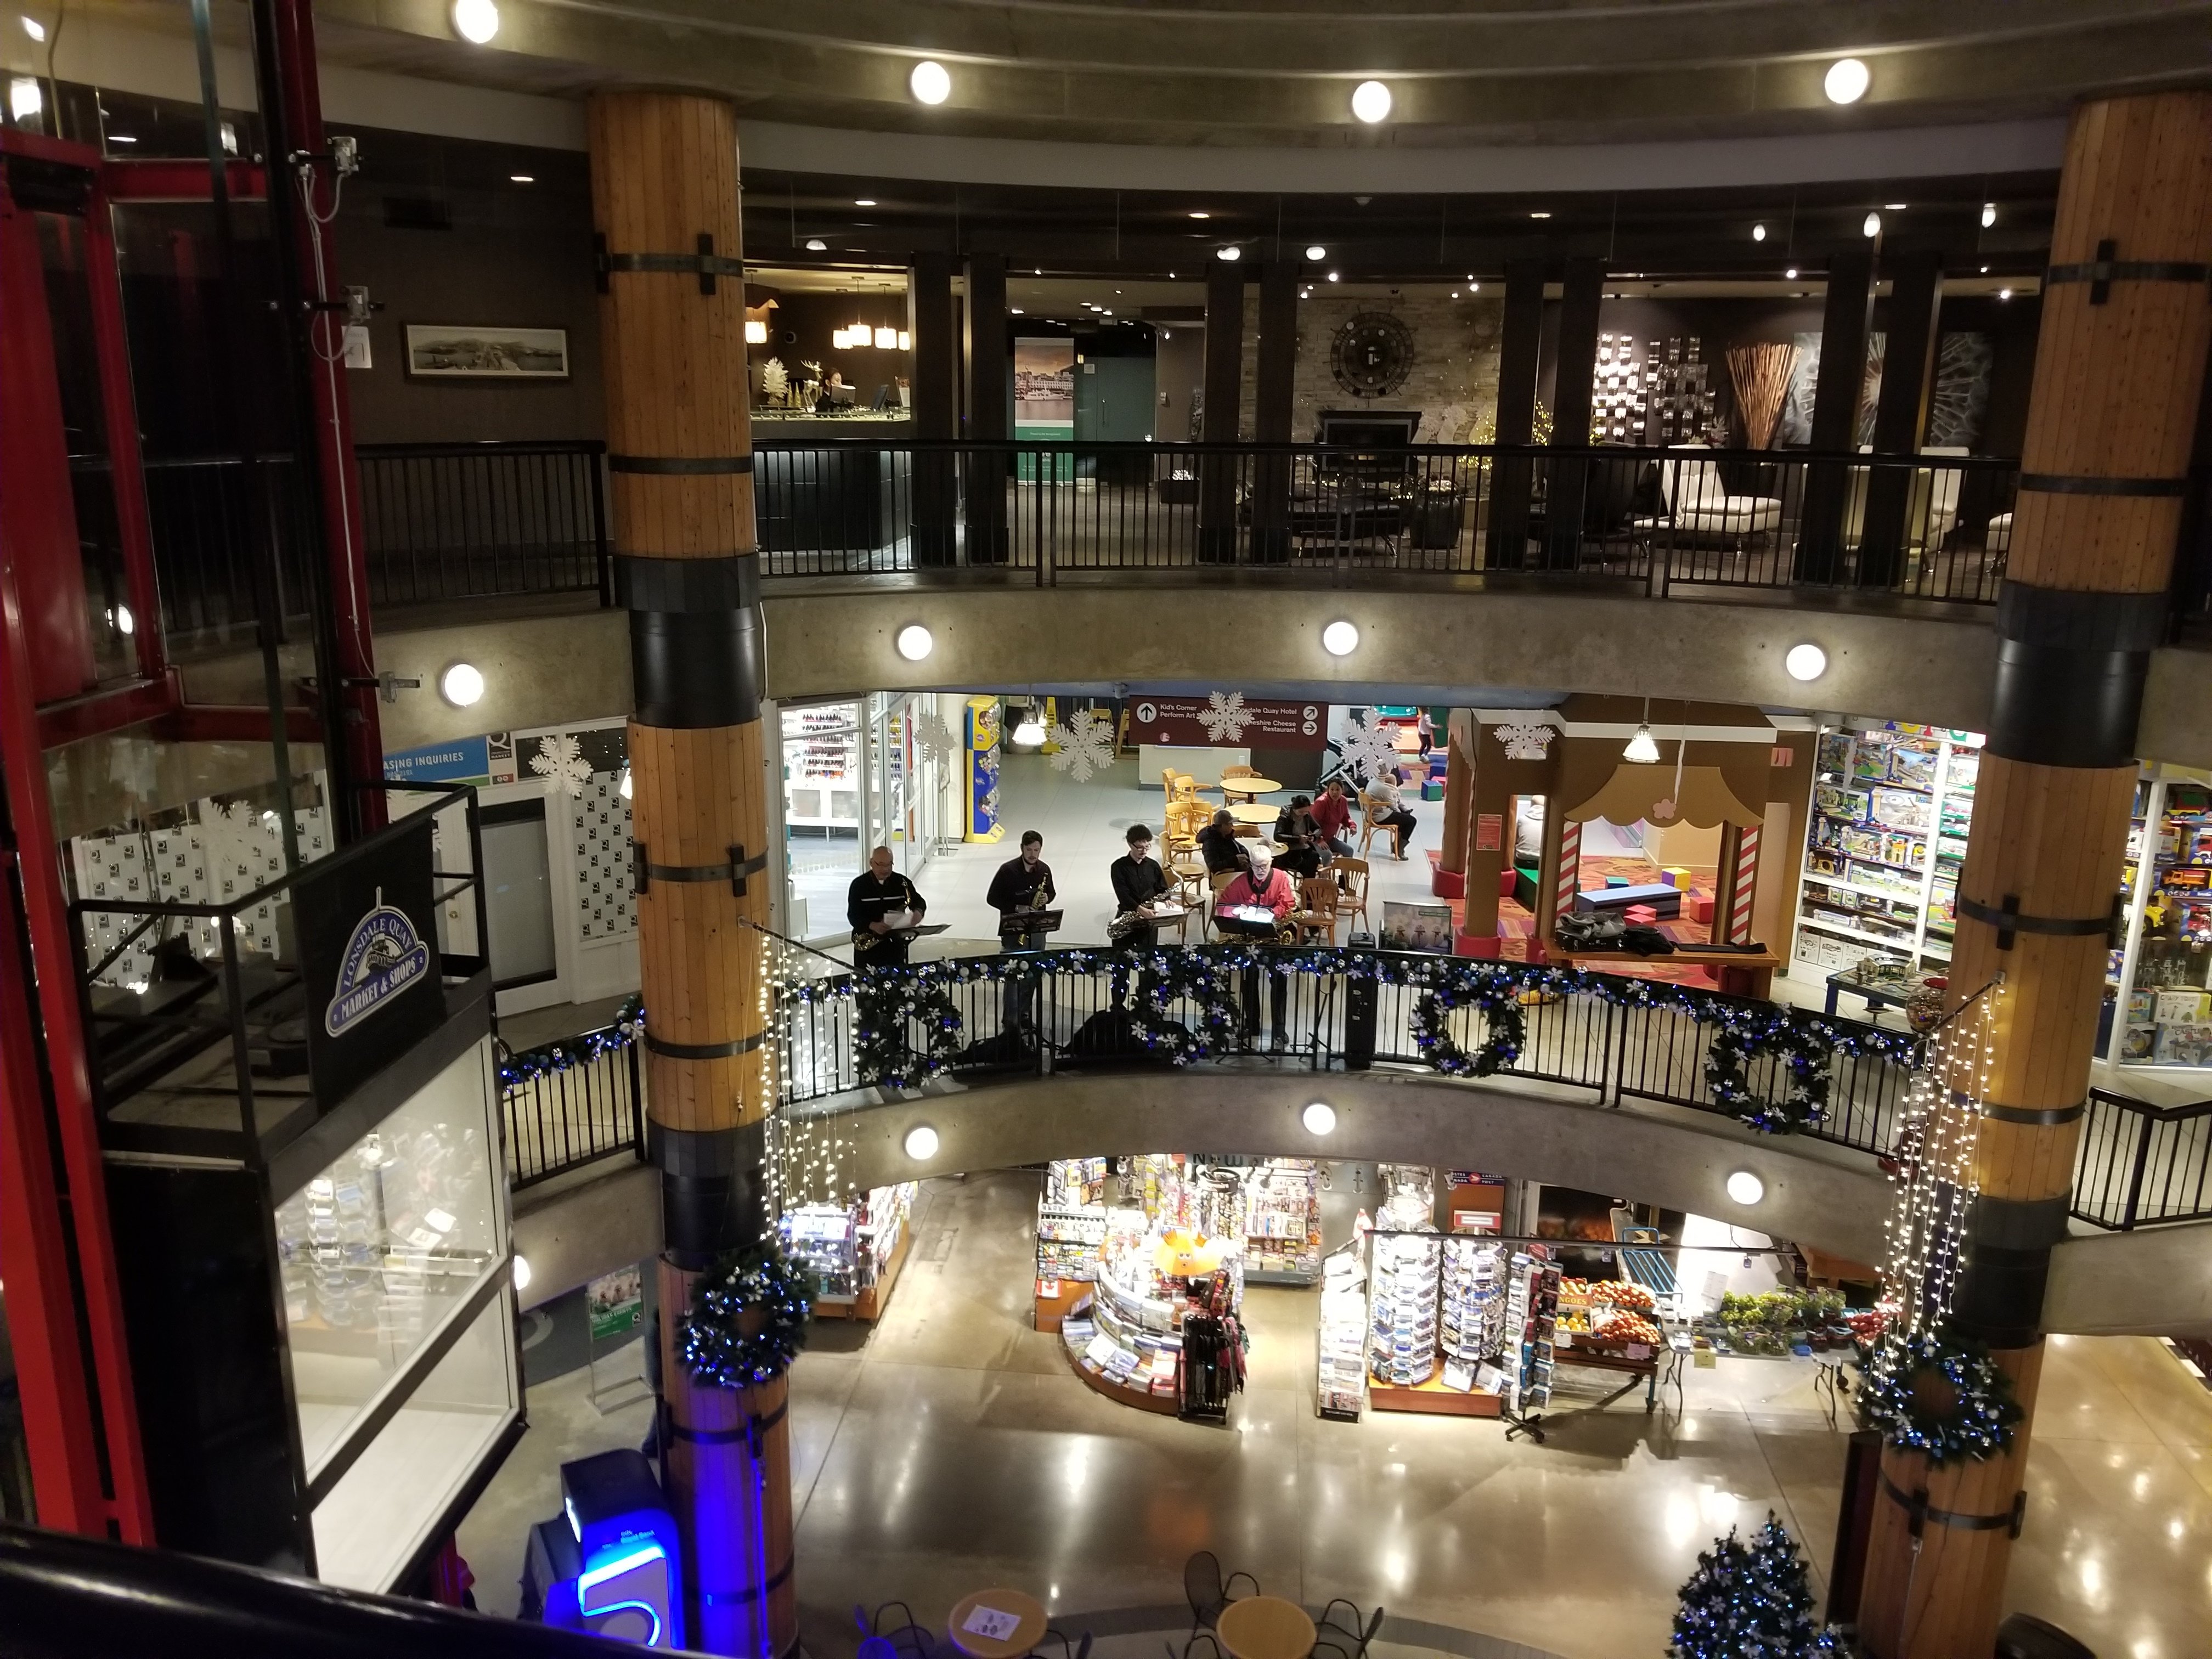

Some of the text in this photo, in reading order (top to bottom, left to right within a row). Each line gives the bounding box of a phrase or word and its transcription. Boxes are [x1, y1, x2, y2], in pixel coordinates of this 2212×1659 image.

[383, 752, 464, 770] ASING INQUIRIES
[343, 918, 412, 987] LONSDALE QUAY
[341, 956, 416, 1020] MARKET & SHOPS
[1559, 1296, 1587, 1305] NGOES
